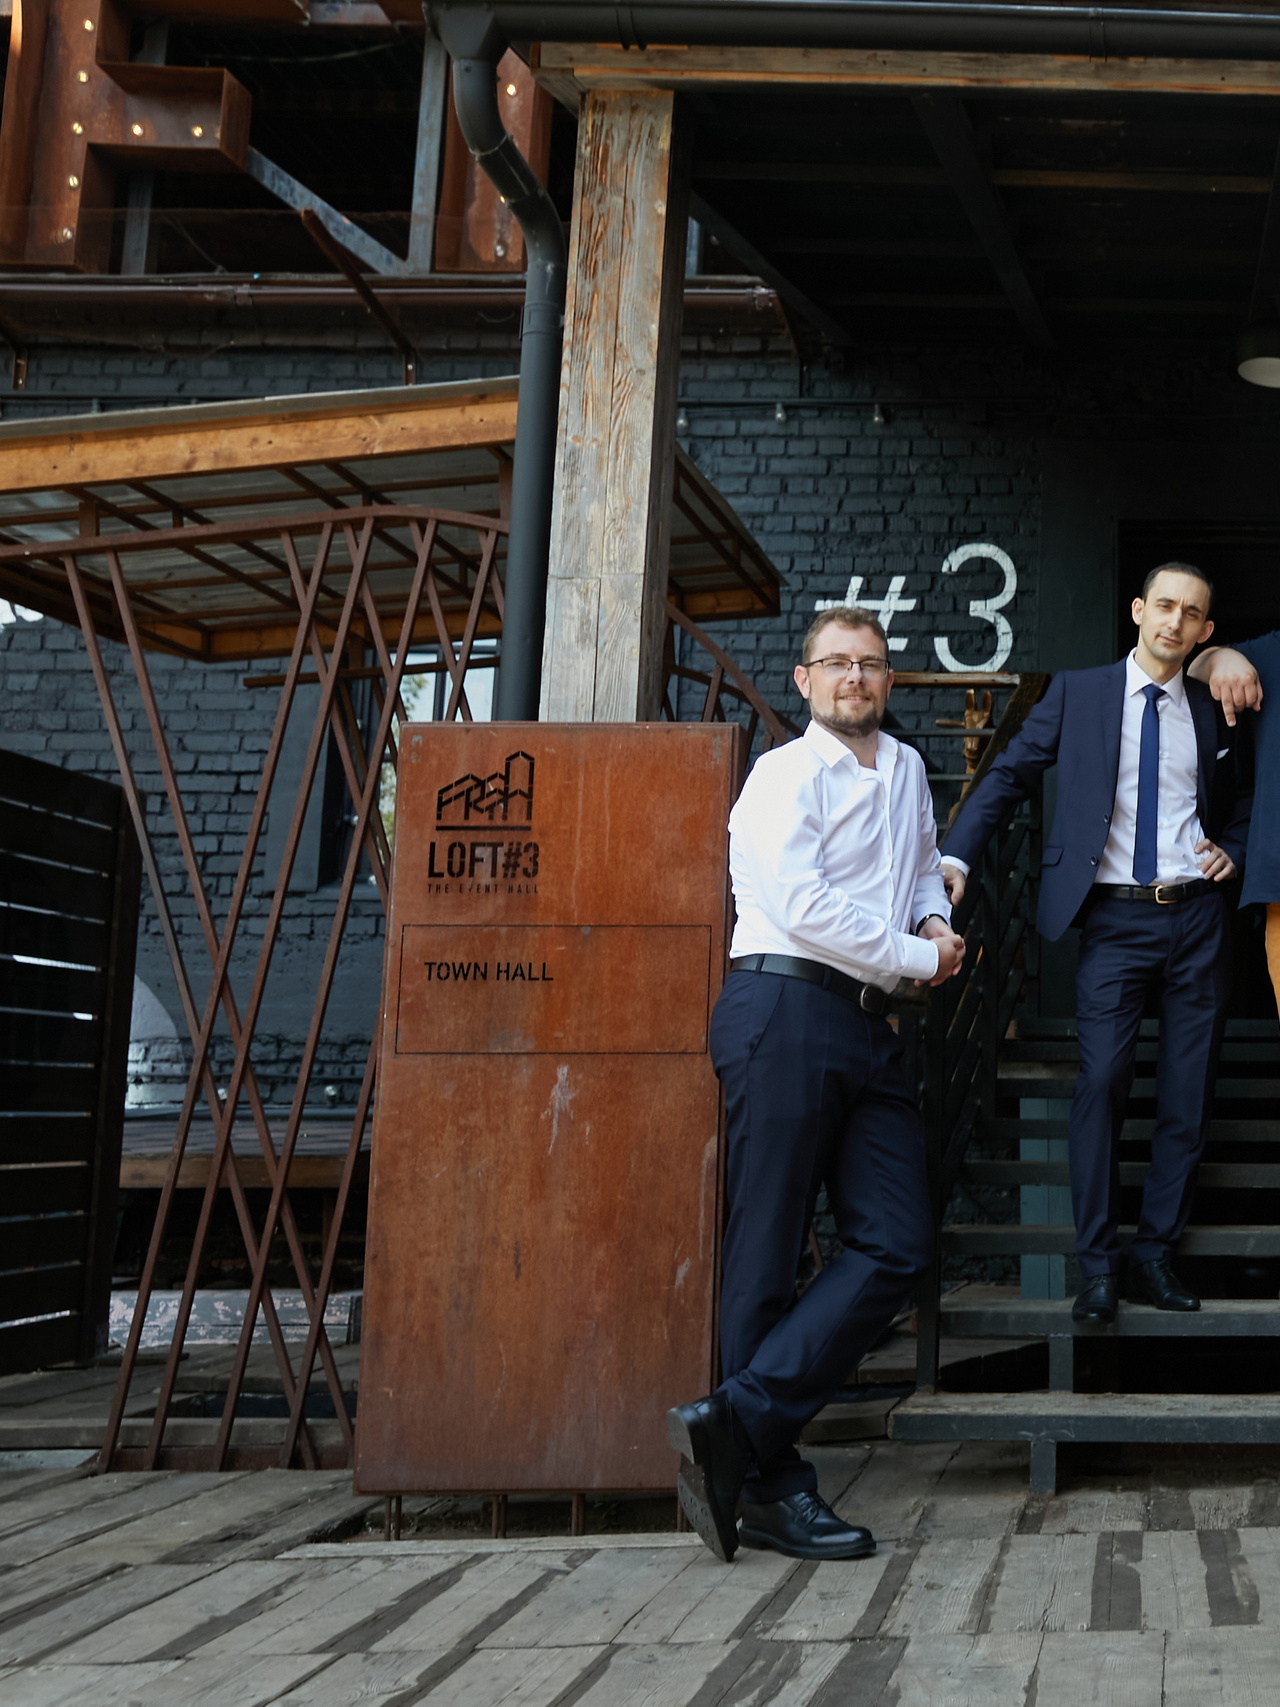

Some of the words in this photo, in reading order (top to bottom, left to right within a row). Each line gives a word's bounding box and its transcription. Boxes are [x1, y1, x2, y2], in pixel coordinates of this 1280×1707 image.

[428, 841, 540, 878] LOFT#3
[428, 883, 449, 894] THE
[459, 883, 498, 894] EVENT
[508, 883, 538, 894] HALL
[424, 962, 488, 981] TOWN
[496, 962, 554, 981] HALL
